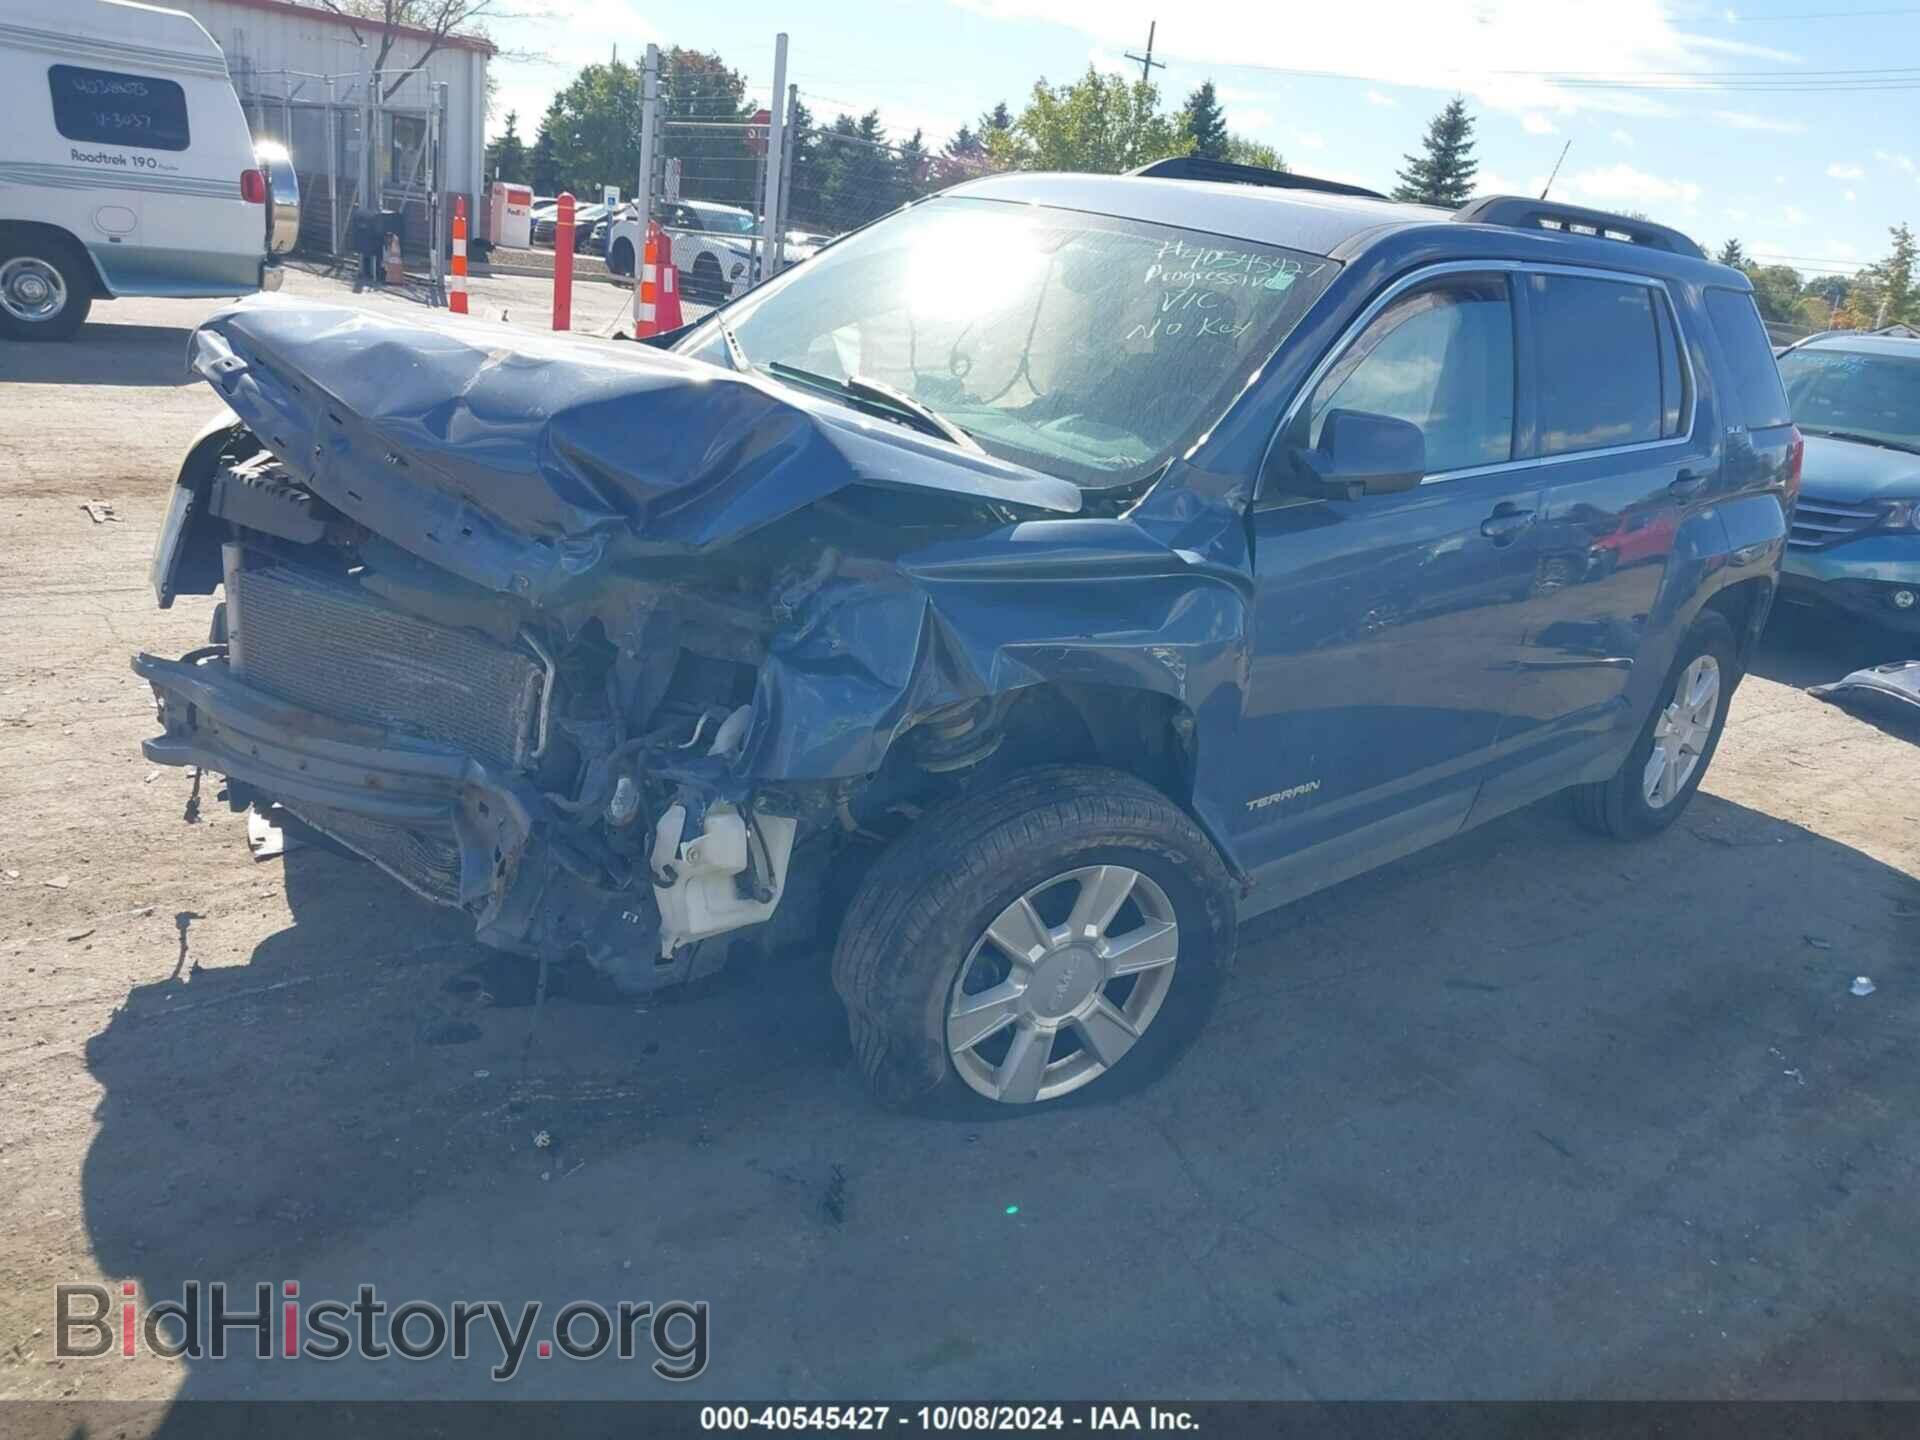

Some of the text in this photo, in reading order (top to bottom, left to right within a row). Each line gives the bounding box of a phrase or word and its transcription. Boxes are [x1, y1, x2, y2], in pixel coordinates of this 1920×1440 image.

[71, 148, 127, 166] Roadtrek
[132, 156, 157, 169] 190
[1245, 779, 1321, 811] TERRAIN
